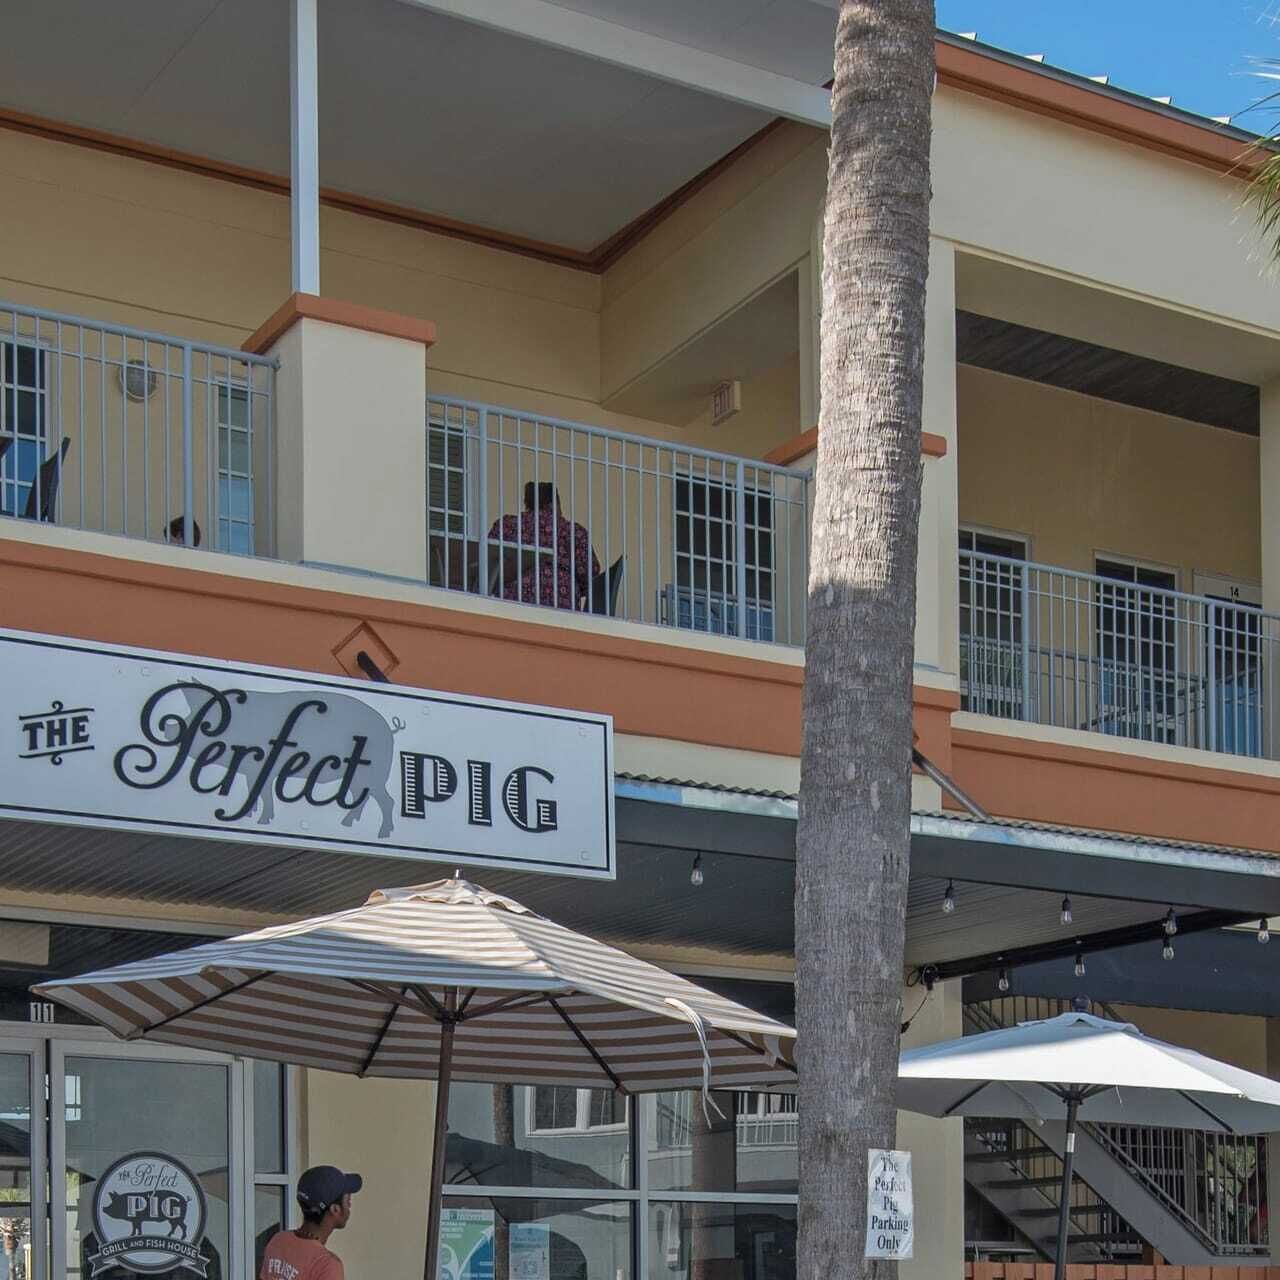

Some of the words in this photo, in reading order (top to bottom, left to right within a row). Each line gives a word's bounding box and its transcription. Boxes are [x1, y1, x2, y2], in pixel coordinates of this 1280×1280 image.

[1230, 585, 1239, 598] 14
[21, 714, 90, 752] THE
[114, 681, 373, 822] Perfect
[400, 750, 559, 833] PIG
[33, 1003, 53, 1023] 11
[881, 1155, 899, 1172] The
[131, 1163, 179, 1198] Perfect
[874, 1176, 906, 1192] Perfect
[127, 1195, 181, 1219] PIG
[882, 1196, 899, 1214] Pig
[871, 1215, 909, 1232] Parking
[102, 1241, 128, 1257] GRILL
[146, 1239, 166, 1249] FISH
[167, 1241, 198, 1259] HOUSE
[877, 1235, 902, 1253] Only
